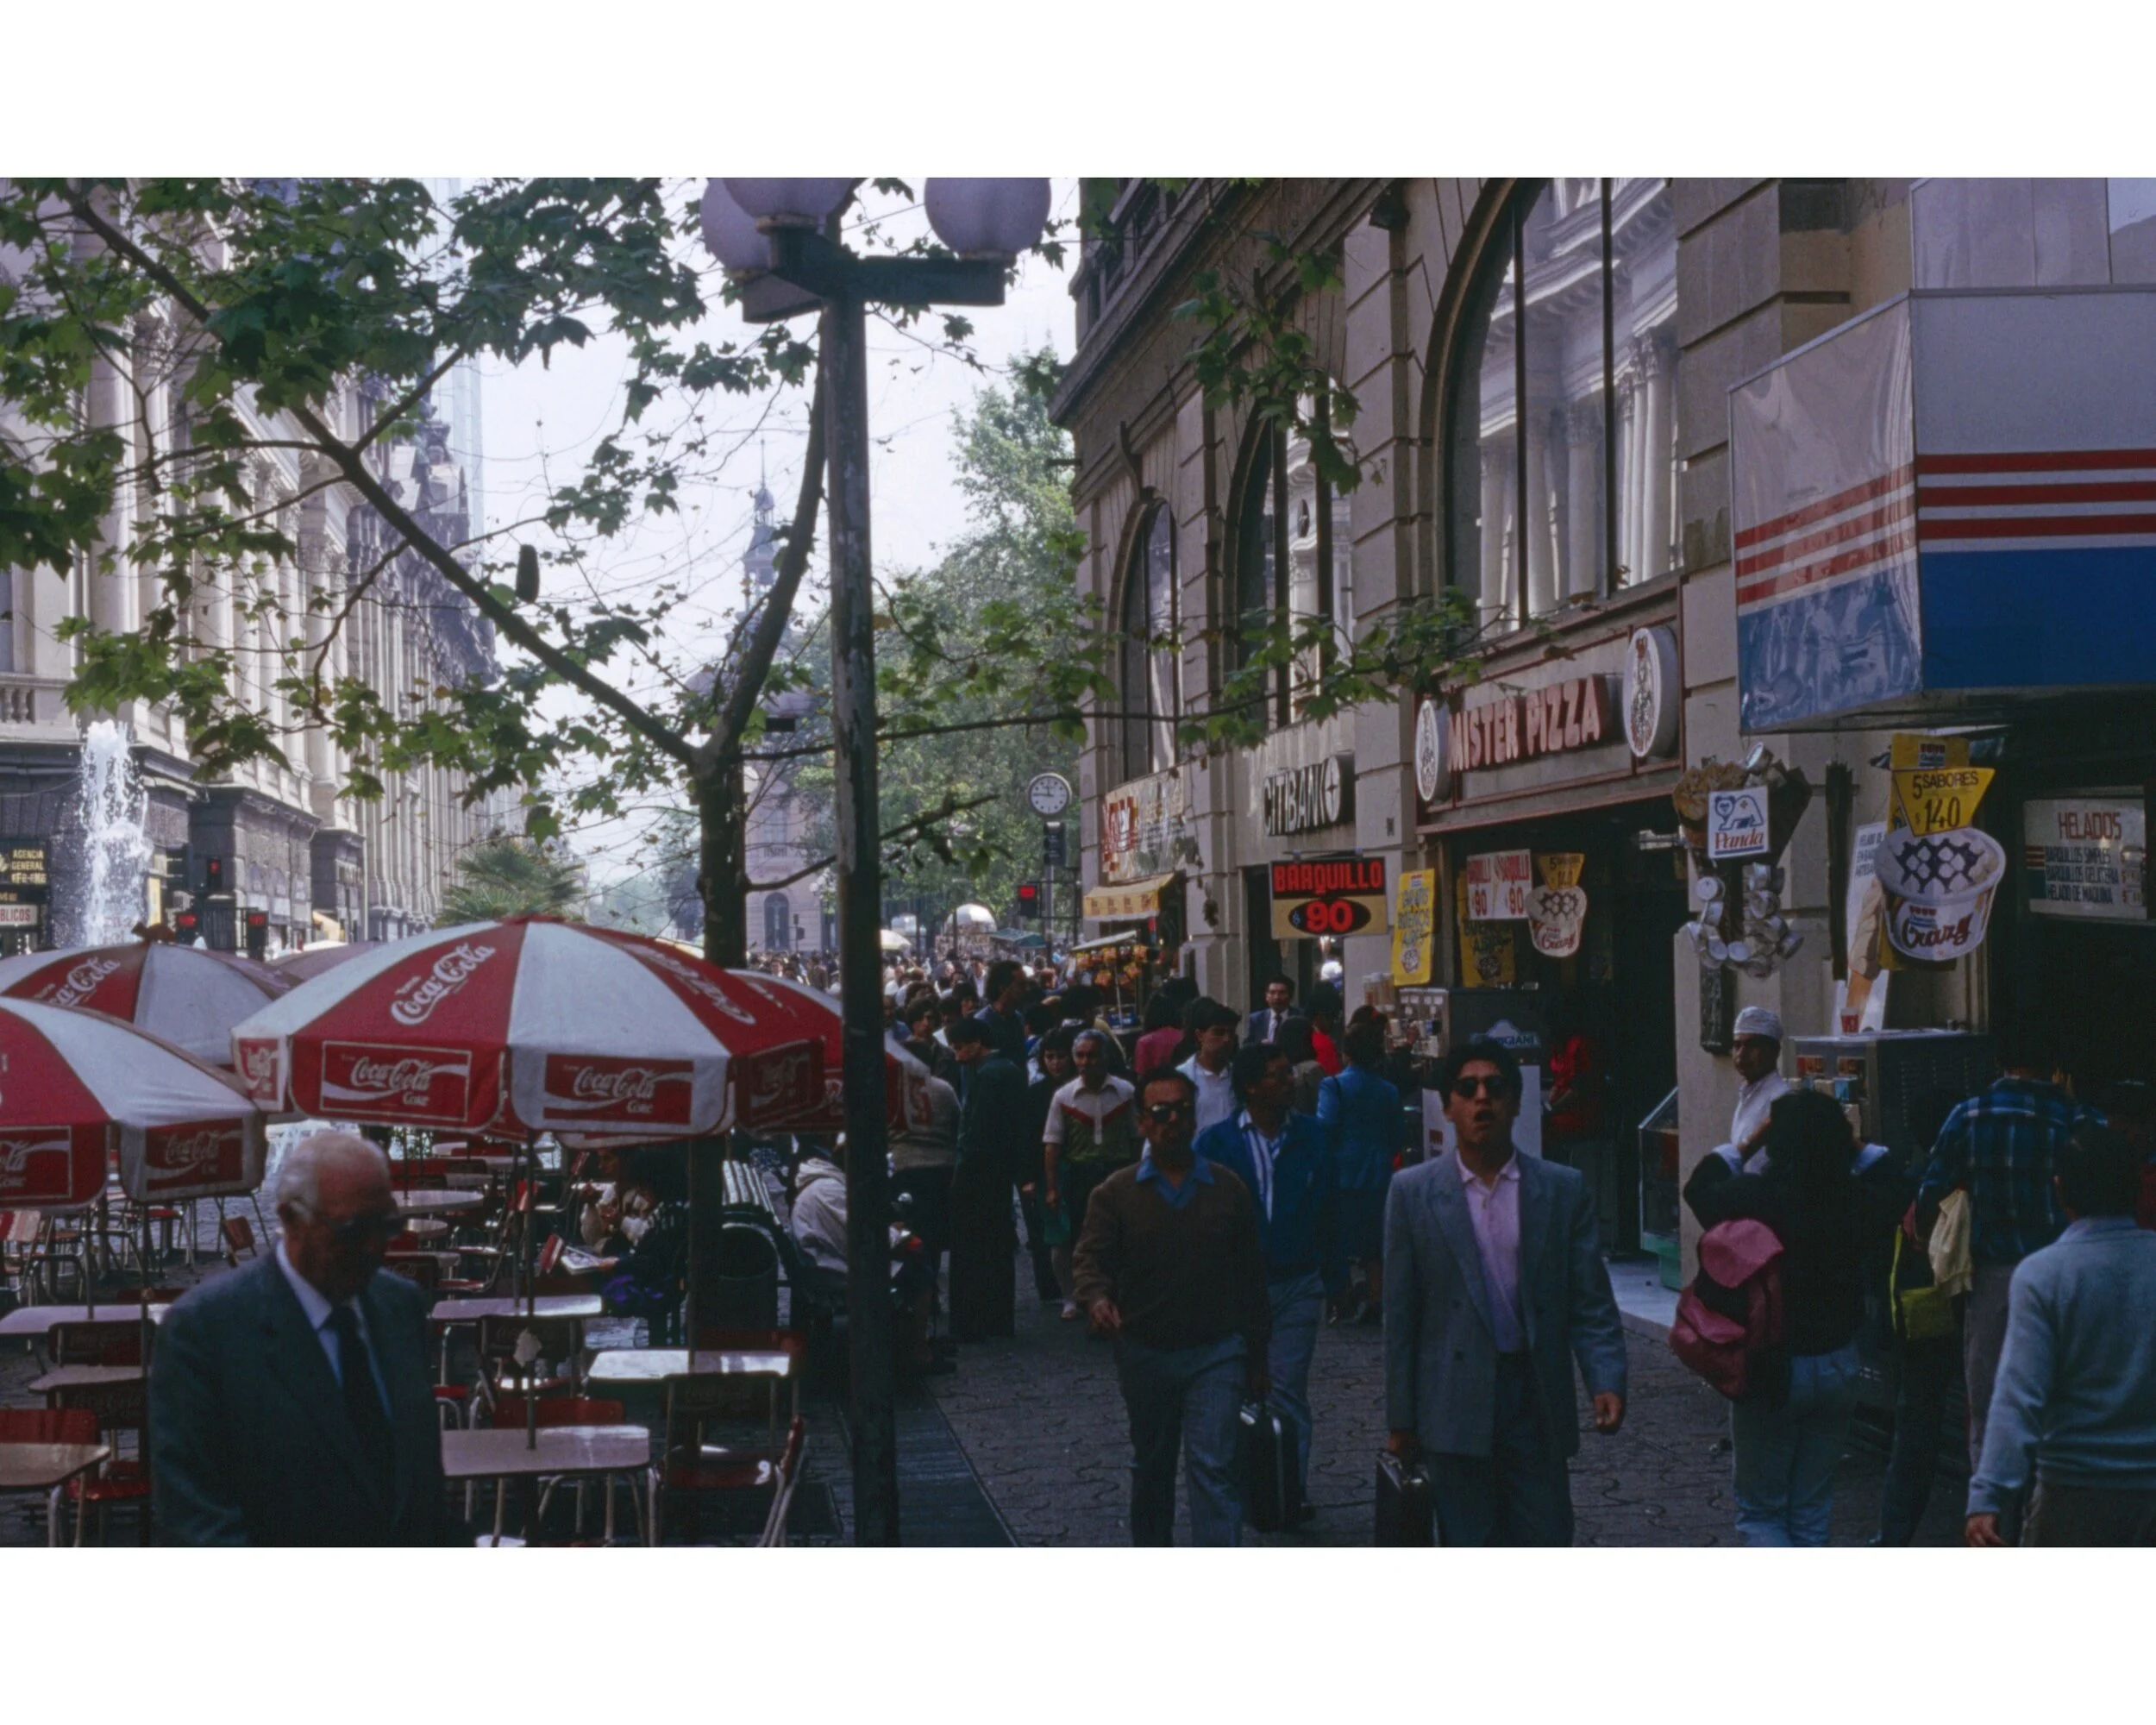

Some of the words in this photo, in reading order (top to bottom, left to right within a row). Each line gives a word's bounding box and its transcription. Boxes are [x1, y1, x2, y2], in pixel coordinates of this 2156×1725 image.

[1447, 697, 1519, 772] MISTER
[1526, 674, 1600, 756] PIZZA
[1912, 775, 1922, 800] 5
[1922, 770, 1979, 790] SABORES
[1924, 796, 1960, 832] 140
[2058, 812, 2122, 840] HELADOS
[13, 850, 44, 860] AGENCIA
[1714, 827, 1764, 850] Panda
[1274, 860, 1383, 894] BARQUILLO
[1306, 900, 1353, 932] 90
[391, 943, 497, 1026] Coca-Cola
[350, 1056, 432, 1091] Coca-Cola
[573, 1066, 655, 1100] Coca-Cola
